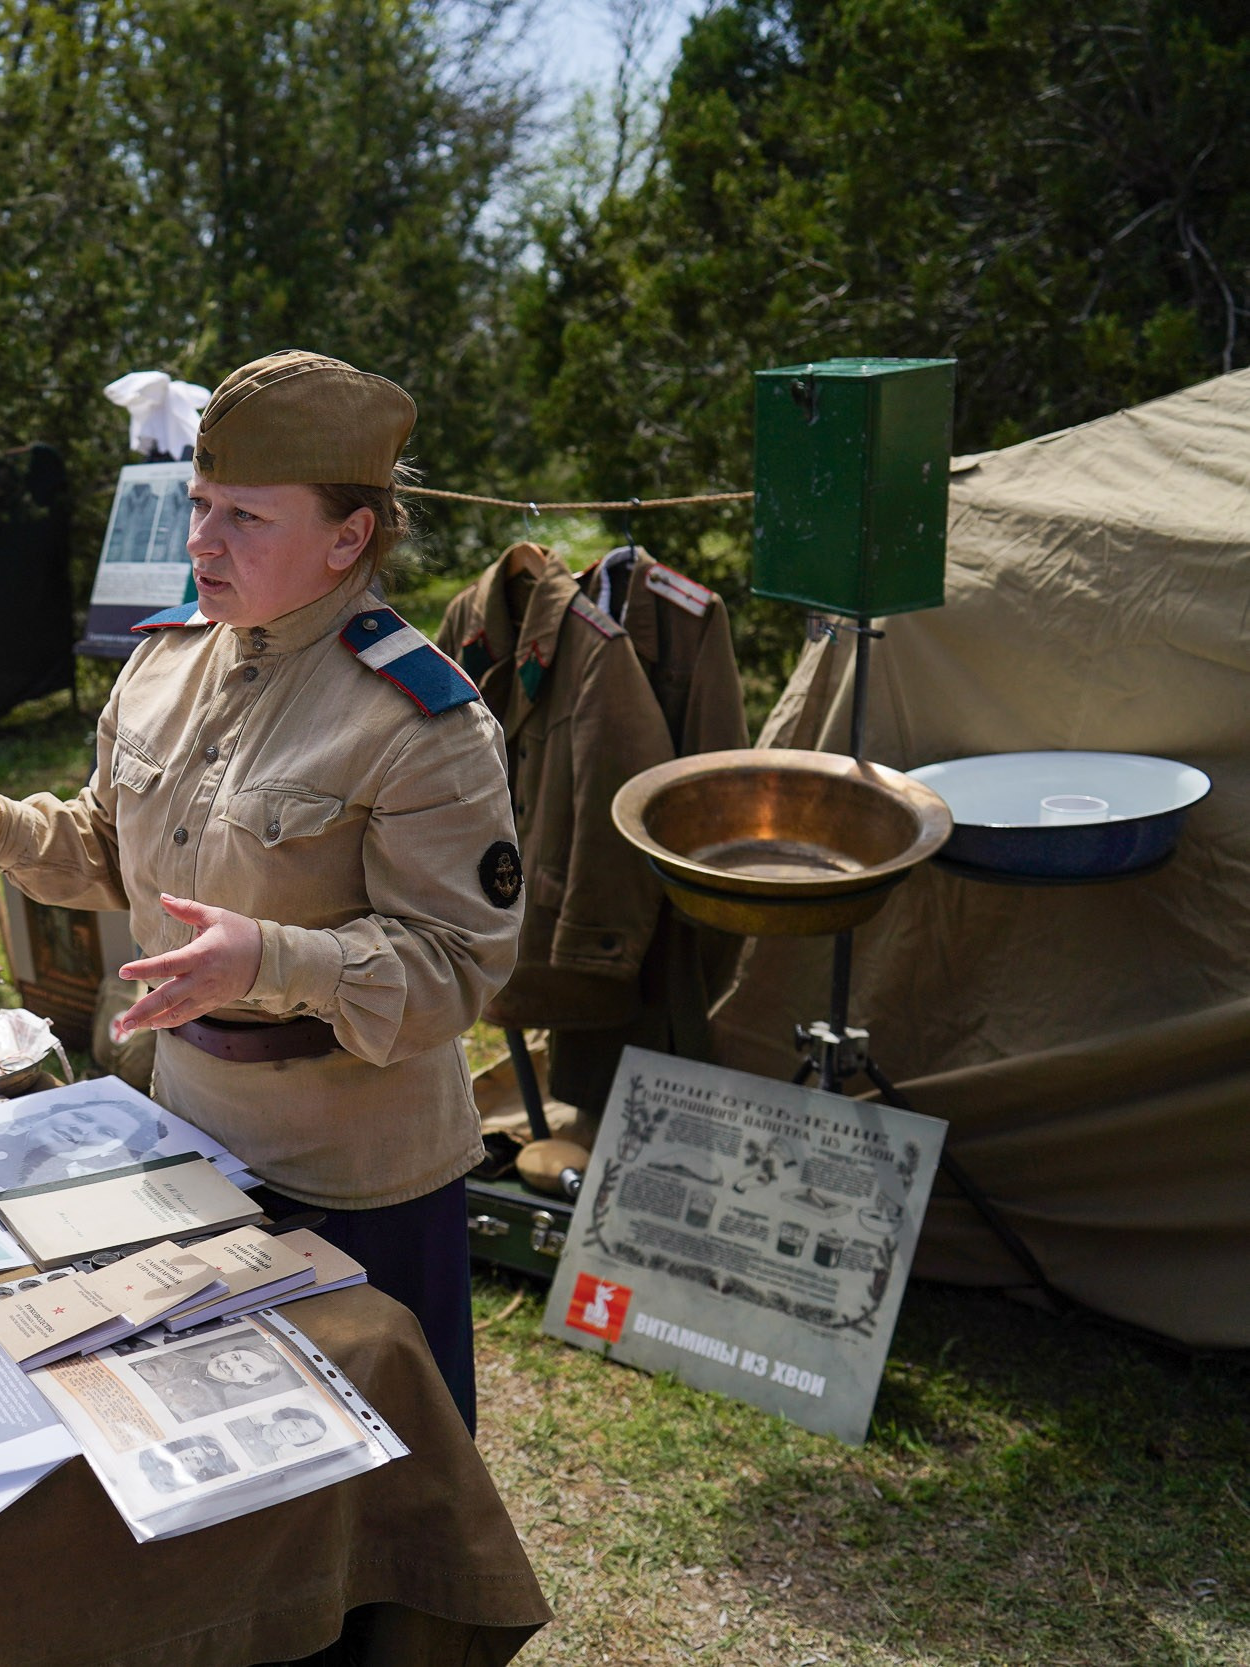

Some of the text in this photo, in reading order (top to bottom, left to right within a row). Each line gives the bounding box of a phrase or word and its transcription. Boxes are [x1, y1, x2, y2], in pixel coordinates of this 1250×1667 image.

[654, 1078, 891, 1147] ПРИГОТОВЛЕНИЕ
[743, 1115, 810, 1142] НАПИТКА
[820, 1134, 841, 1150] ИЗ
[851, 1141, 896, 1163] ХВОИ
[223, 1246, 263, 1273] СПРАВОЧНИК
[232, 1243, 272, 1270] САНИТАРНЫЙ
[246, 1243, 272, 1262] ВОЕННО-
[135, 1262, 172, 1290] СПРАВОЧНИК
[144, 1258, 183, 1285] САНИТАРНЫЙ
[159, 1258, 183, 1276] ВОЕННО-
[24, 1303, 55, 1333] РУКОВОДСТВО
[632, 1312, 739, 1368] ВИТАМИНЫ
[740, 1350, 768, 1377] ИЗ
[770, 1361, 827, 1398] ХВОИ
